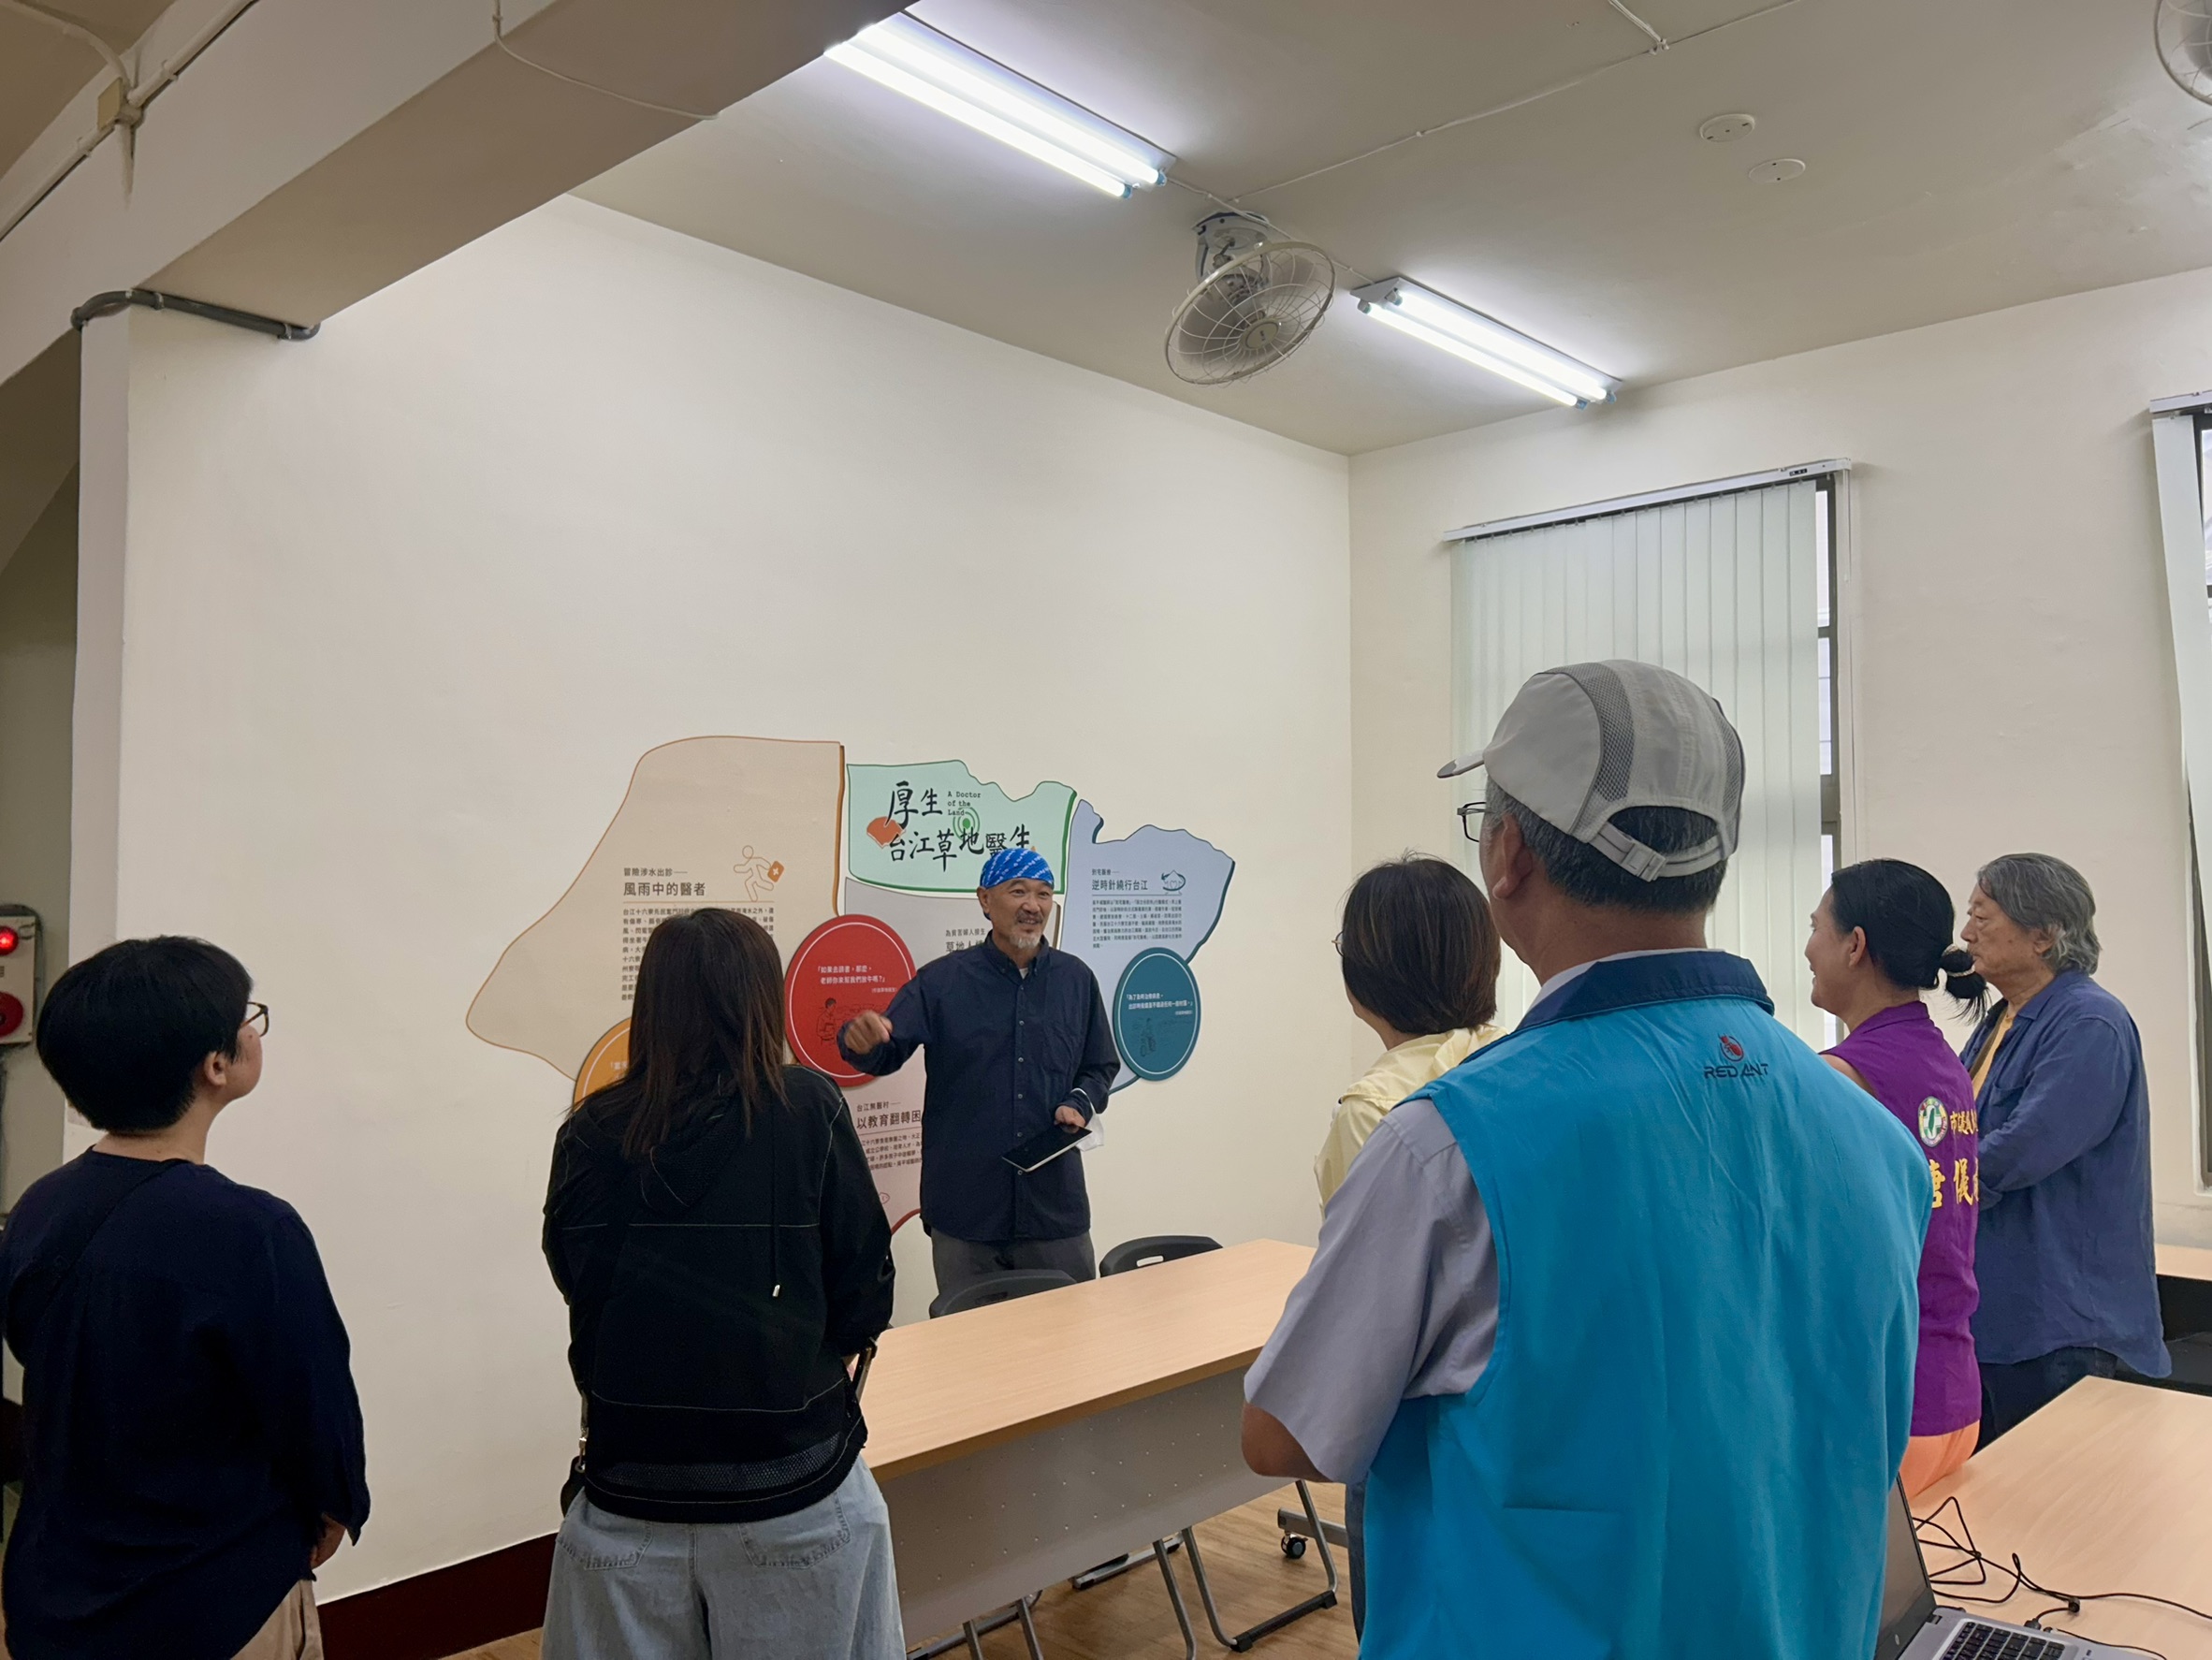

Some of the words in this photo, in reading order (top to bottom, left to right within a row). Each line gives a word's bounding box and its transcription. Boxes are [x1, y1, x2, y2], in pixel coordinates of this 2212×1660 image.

[884, 780, 943, 830] 厚生
[623, 881, 706, 896] 風雨中的醫者
[1092, 879, 1148, 892] 逆時針繞行台江
[1704, 1065, 1739, 1080] RED
[1739, 1063, 1768, 1078] ANT
